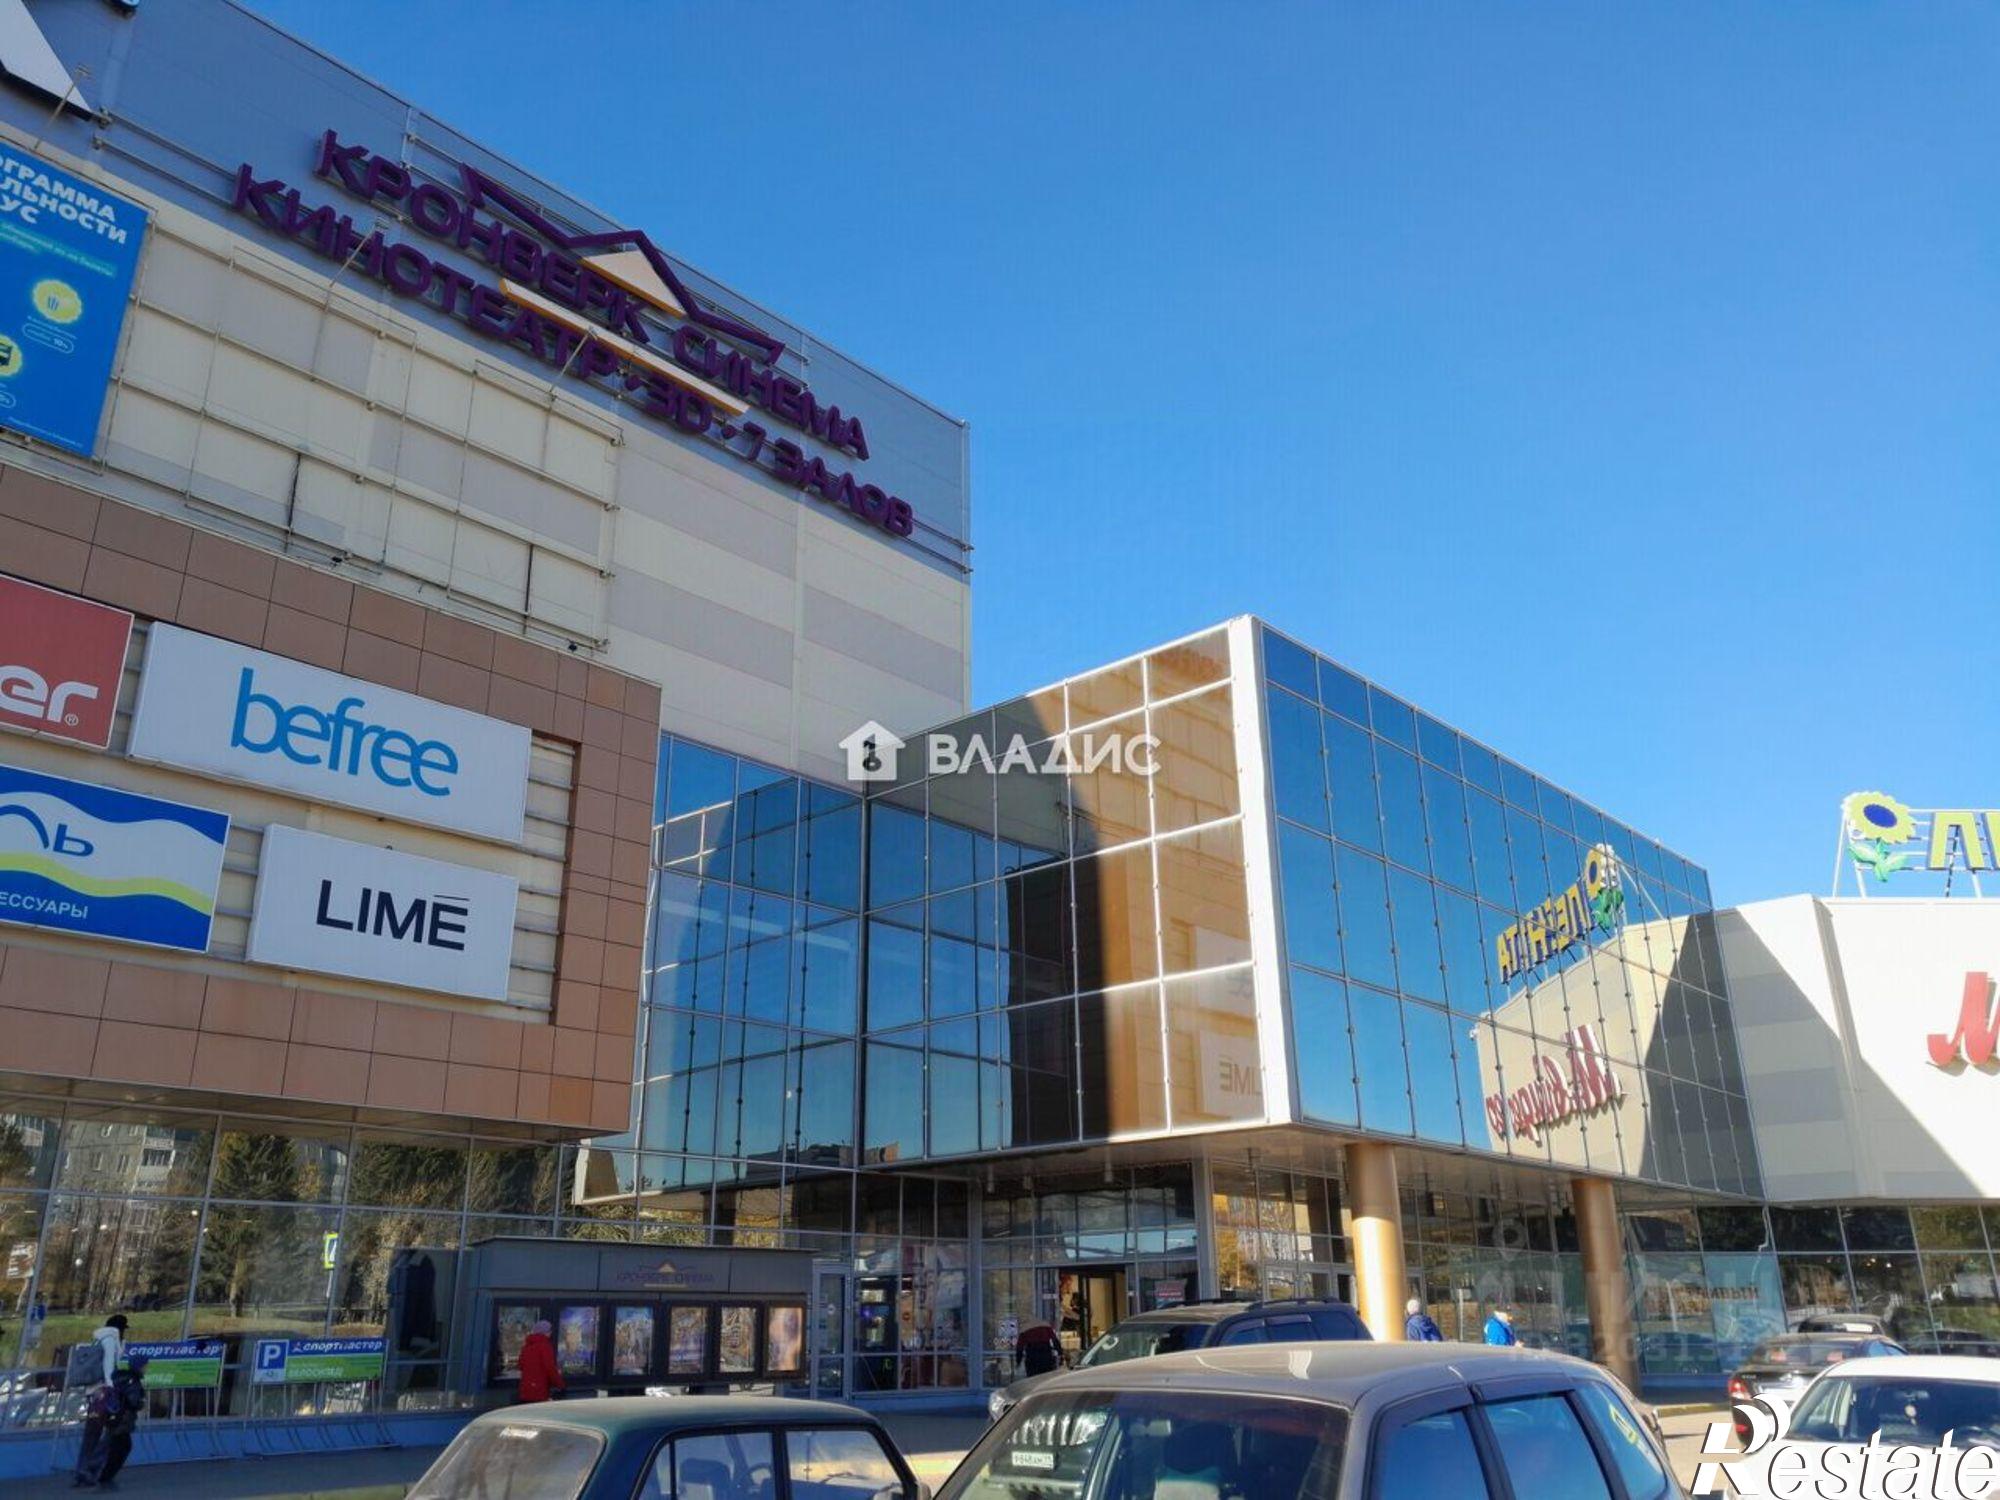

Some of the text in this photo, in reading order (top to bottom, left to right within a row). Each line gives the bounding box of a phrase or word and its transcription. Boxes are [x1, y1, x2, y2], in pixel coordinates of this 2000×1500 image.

[0, 154, 116, 223] ГРАММА
[312, 128, 650, 344] КРОНВЕРК
[230, 666, 459, 797] befree
